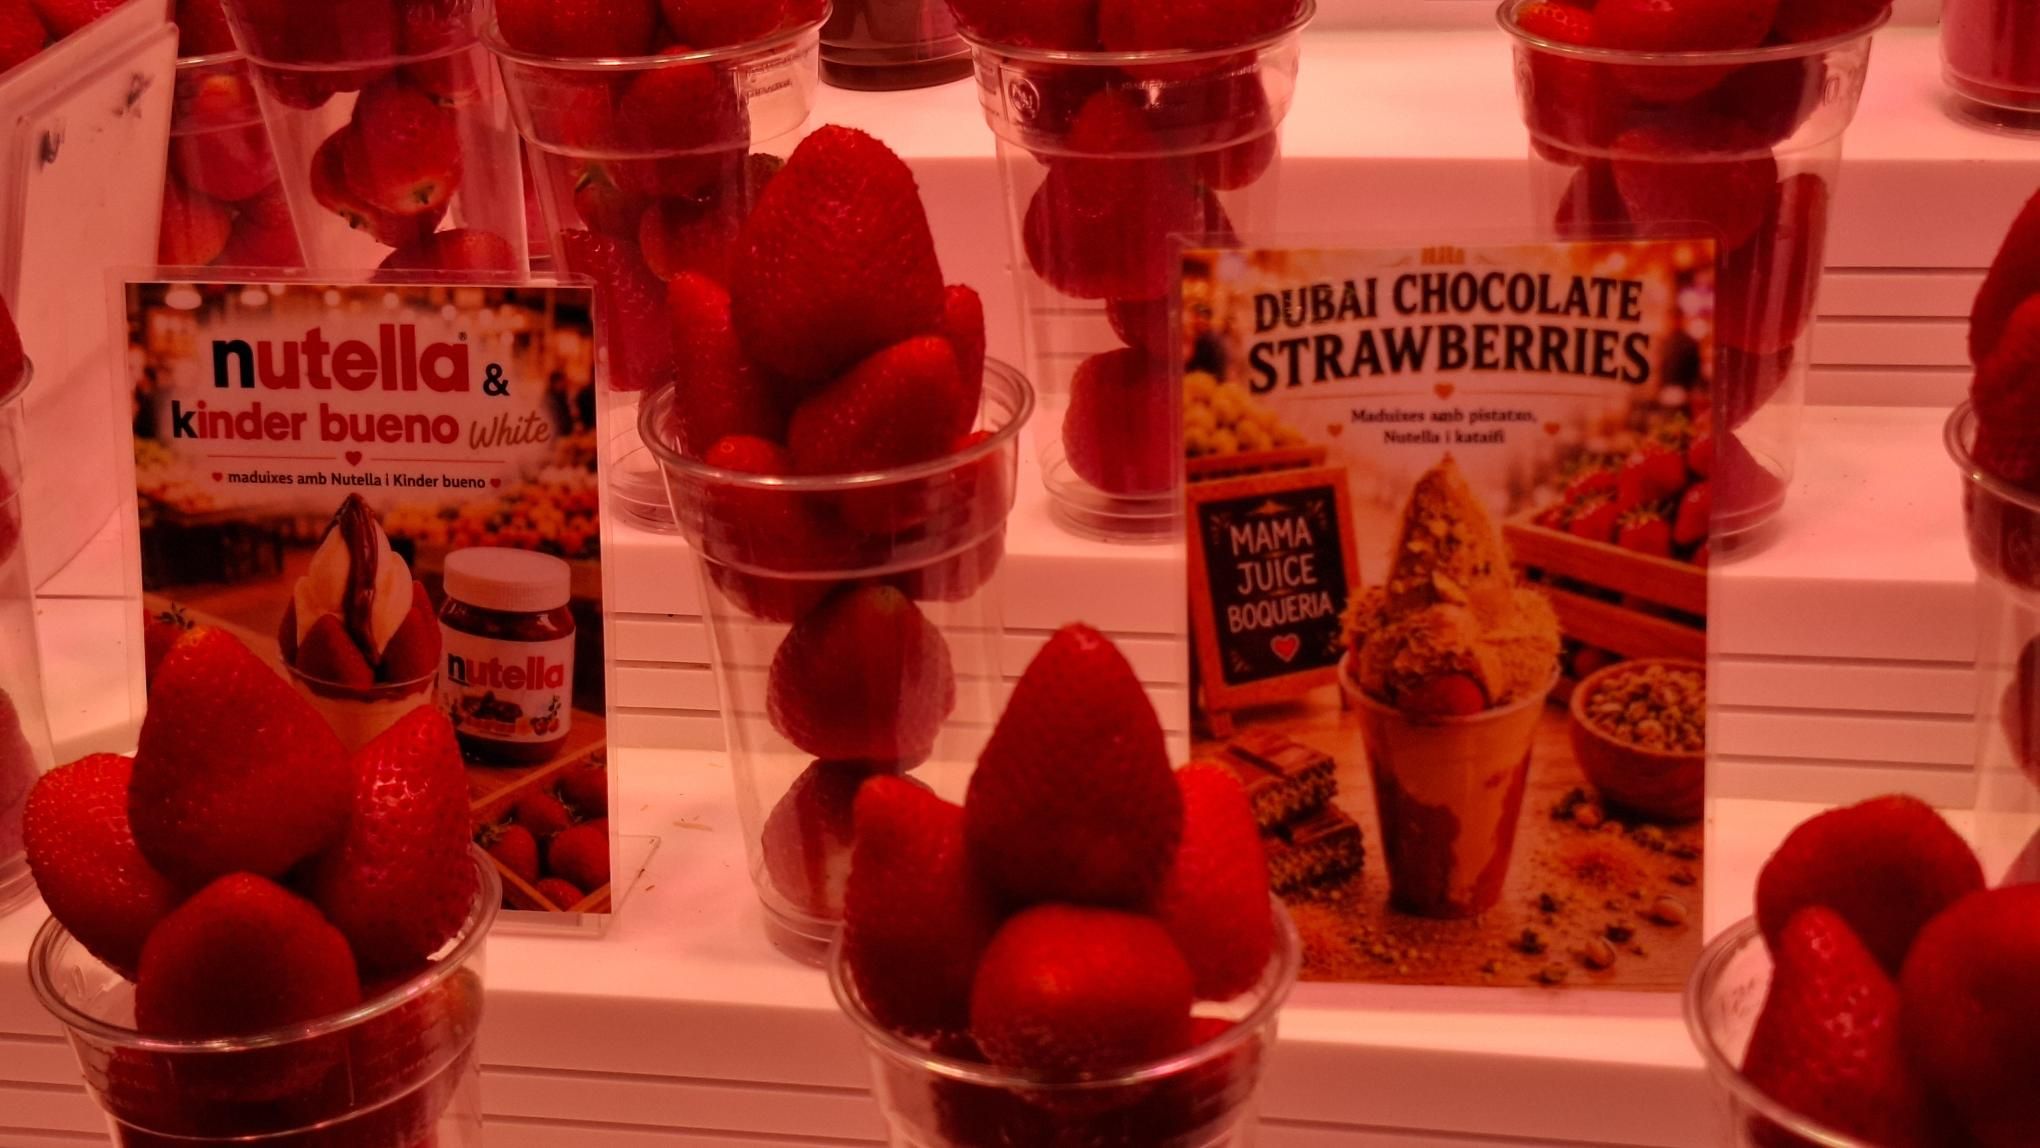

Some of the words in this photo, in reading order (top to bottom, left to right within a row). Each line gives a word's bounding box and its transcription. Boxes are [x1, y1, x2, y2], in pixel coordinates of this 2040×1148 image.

[1254, 277, 1379, 333] DUBAI
[1392, 271, 1643, 322] CHOCOLATE
[1247, 323, 1651, 395] STRAWBERRIES
[483, 363, 511, 397] &
[172, 400, 307, 441] kinder
[319, 402, 460, 445] bueno
[469, 409, 550, 450] White
[1351, 408, 1425, 424] Maduixes
[1430, 408, 1464, 423] amb
[1468, 408, 1538, 425] pistatxo,
[1383, 429, 1440, 444] Nutella
[1454, 428, 1505, 444] kataifi
[228, 470, 294, 485] maduixes
[297, 472, 328, 485] amb
[331, 472, 382, 486] Nutella
[393, 473, 438, 488] Kinder
[442, 474, 486, 489] bueno
[1230, 516, 1313, 556] MAMA
[1236, 553, 1318, 595] JUICE
[1227, 591, 1334, 634] BOQUERIA
[447, 653, 564, 690] nutella
